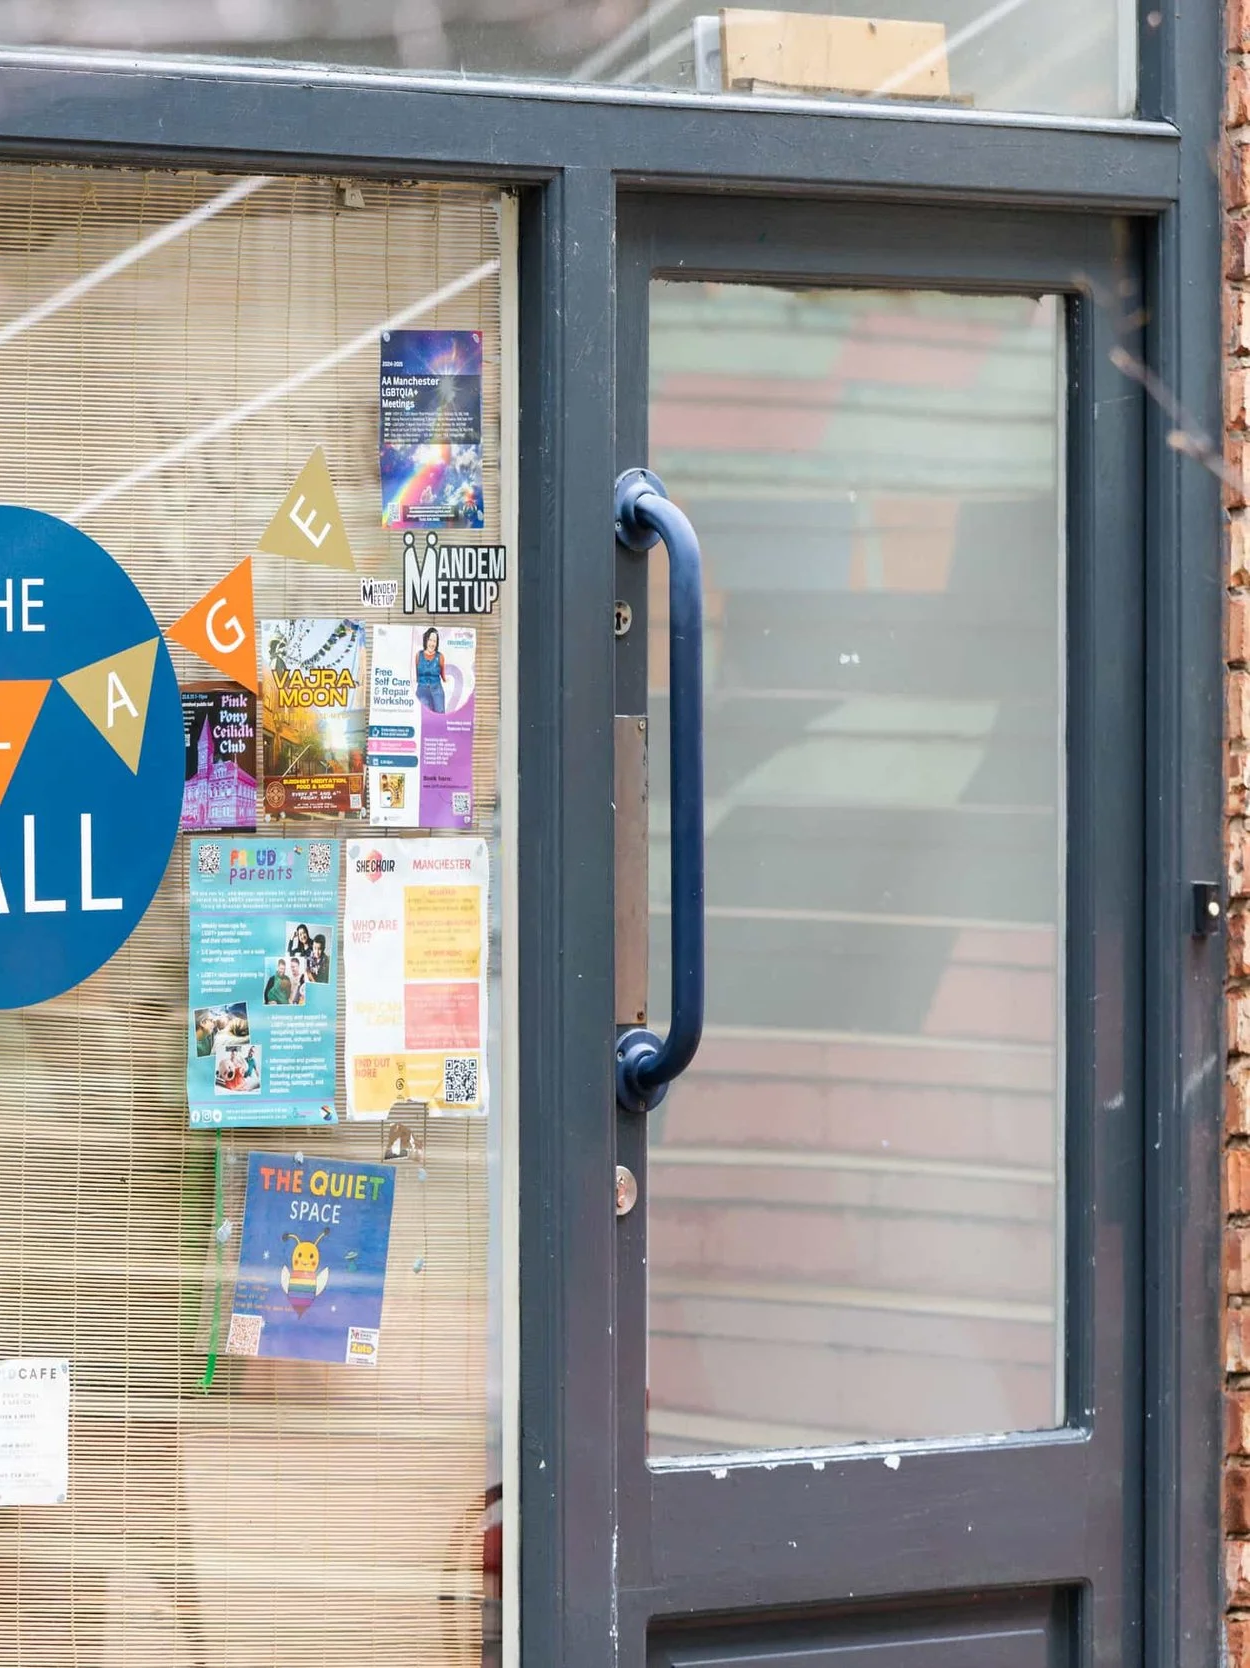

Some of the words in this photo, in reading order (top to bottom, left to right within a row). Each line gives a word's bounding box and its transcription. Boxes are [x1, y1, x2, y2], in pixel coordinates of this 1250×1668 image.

[382, 377, 391, 386] AA
[393, 377, 439, 386] Manchester
[382, 388, 418, 397] LGBTQIA+
[382, 399, 415, 410] Meetings
[375, 668, 392, 676] Free
[271, 668, 355, 689] VAJRA
[375, 678, 390, 686] Self
[392, 678, 410, 686] Care
[279, 688, 348, 707] MOON
[382, 688, 409, 698] Repair
[222, 694, 248, 707] Pink
[374, 697, 414, 707] Workshop
[220, 711, 247, 726] Pony
[213, 725, 254, 738] Ceilidh
[220, 741, 246, 753] Club
[413, 859, 471, 870] MANCHESTER
[230, 867, 293, 885] parents
[352, 920, 376, 931] WHO
[378, 920, 398, 930] ARE
[352, 932, 372, 943] WE?
[260, 1168, 303, 1193] THE
[309, 1170, 385, 1200] QUIET
[289, 1200, 342, 1224] SPACE
